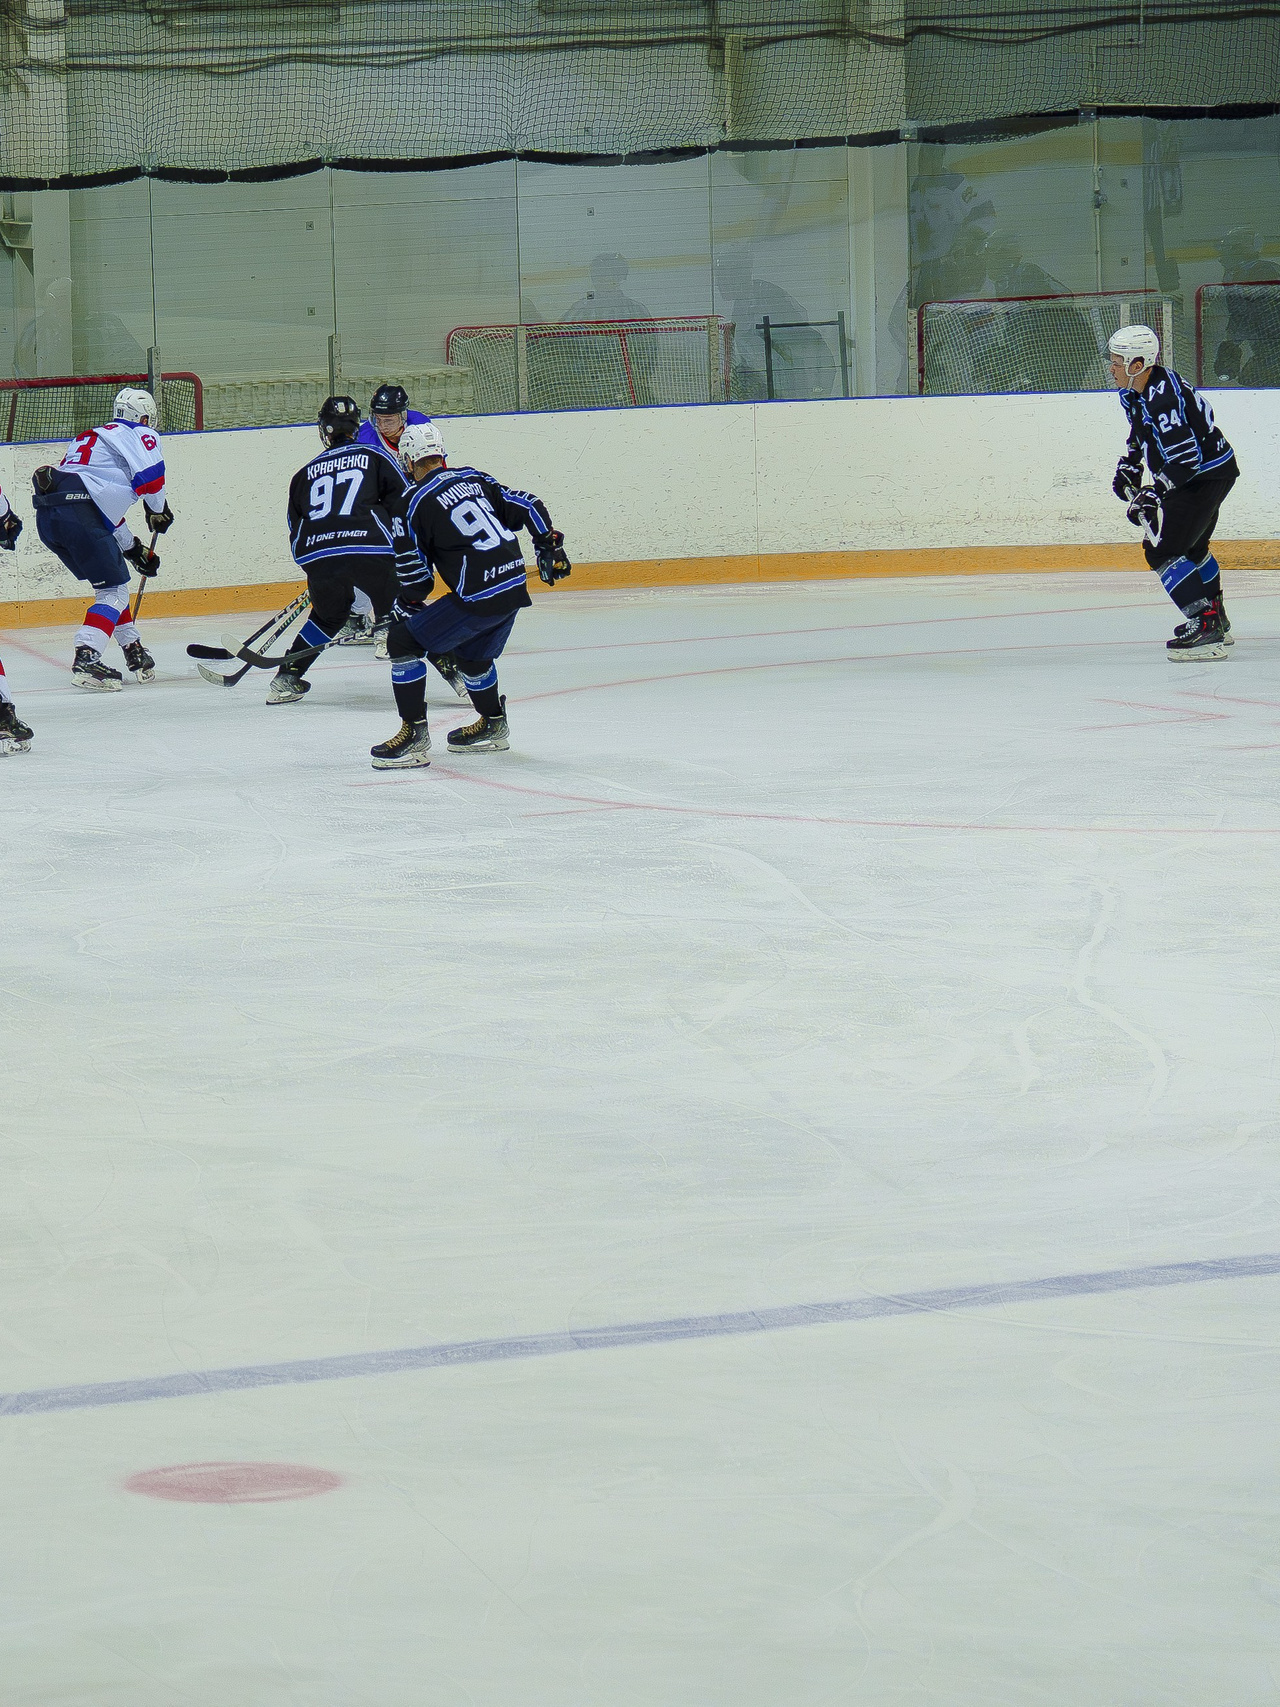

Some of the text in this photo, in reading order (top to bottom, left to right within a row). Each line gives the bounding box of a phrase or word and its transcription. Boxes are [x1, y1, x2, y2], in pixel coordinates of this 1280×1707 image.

[1158, 408, 1182, 433] 24
[60, 429, 99, 466] 3
[307, 454, 369, 480] КРАВЧЕНКО
[308, 469, 365, 521] 97
[316, 530, 368, 542] ONE TIMER
